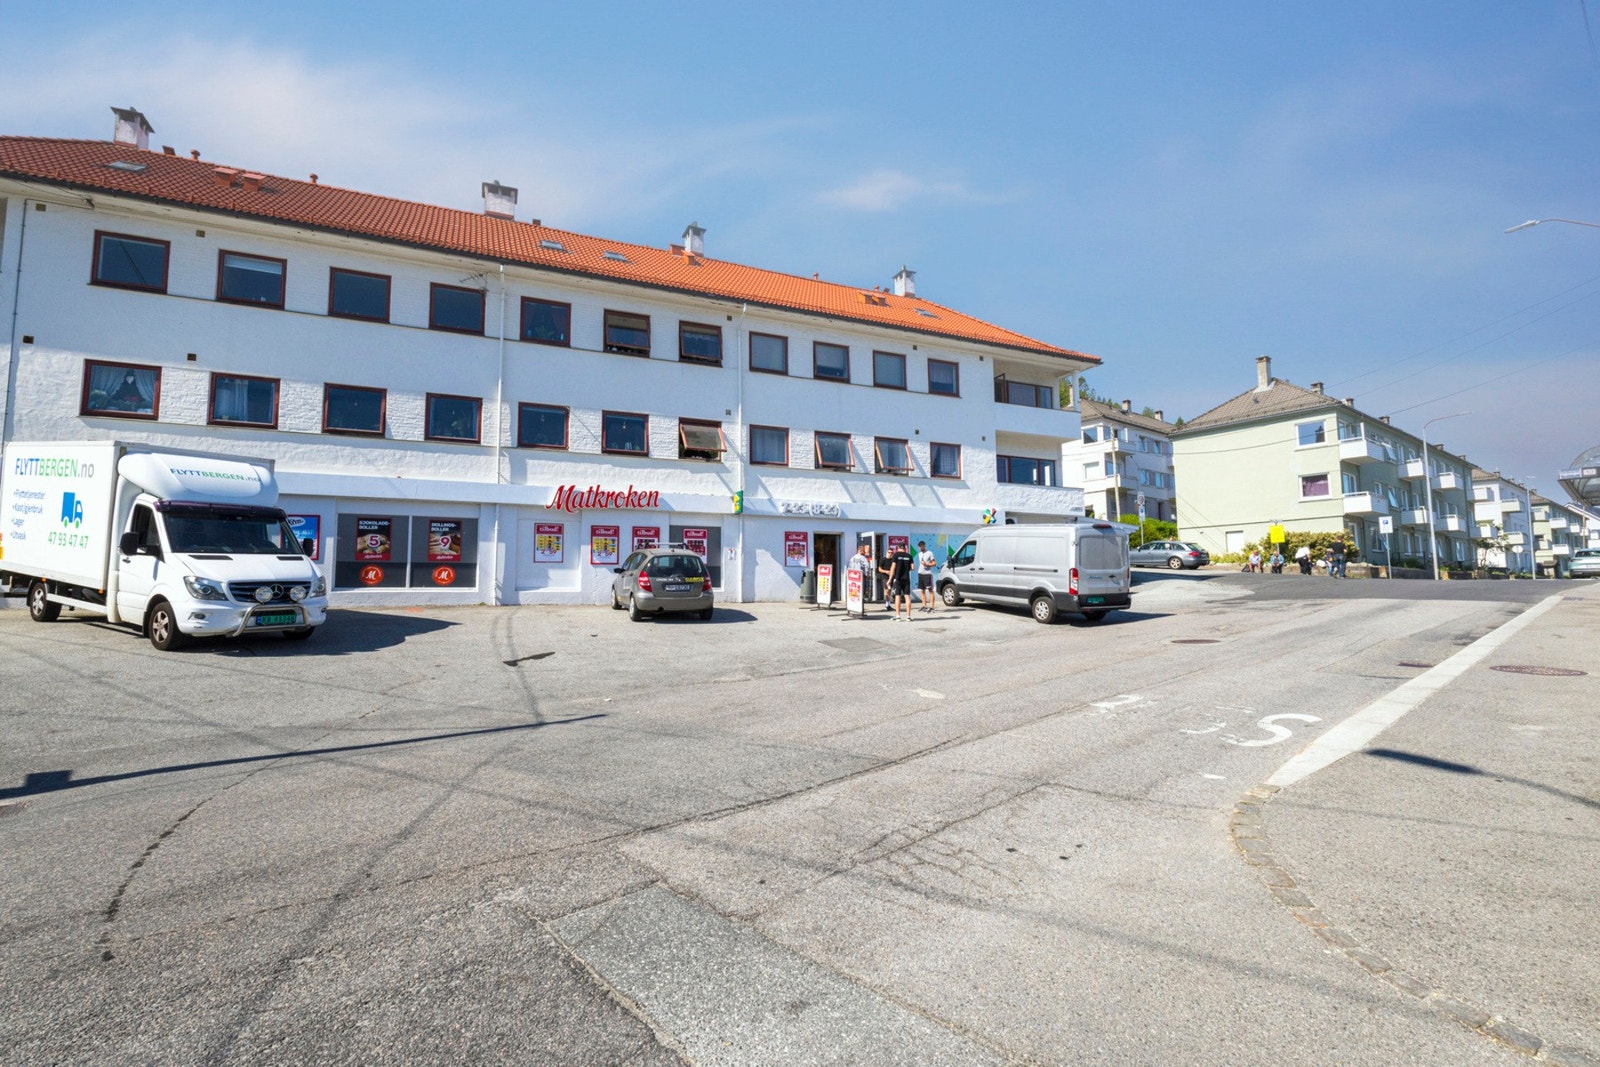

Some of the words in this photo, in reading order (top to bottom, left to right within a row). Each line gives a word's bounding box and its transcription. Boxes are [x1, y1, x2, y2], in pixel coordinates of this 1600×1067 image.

[15, 457, 95, 478] FLYTTBERGEN.no
[169, 468, 261, 482] FLYTTBERGEN.no
[546, 485, 659, 513] Matkroken
[48, 531, 57, 545] 47
[58, 532, 67, 546] 93
[68, 533, 78, 548] 47
[79, 535, 89, 549] 47
[369, 535, 379, 547] 5
[440, 536, 450, 547] 9
